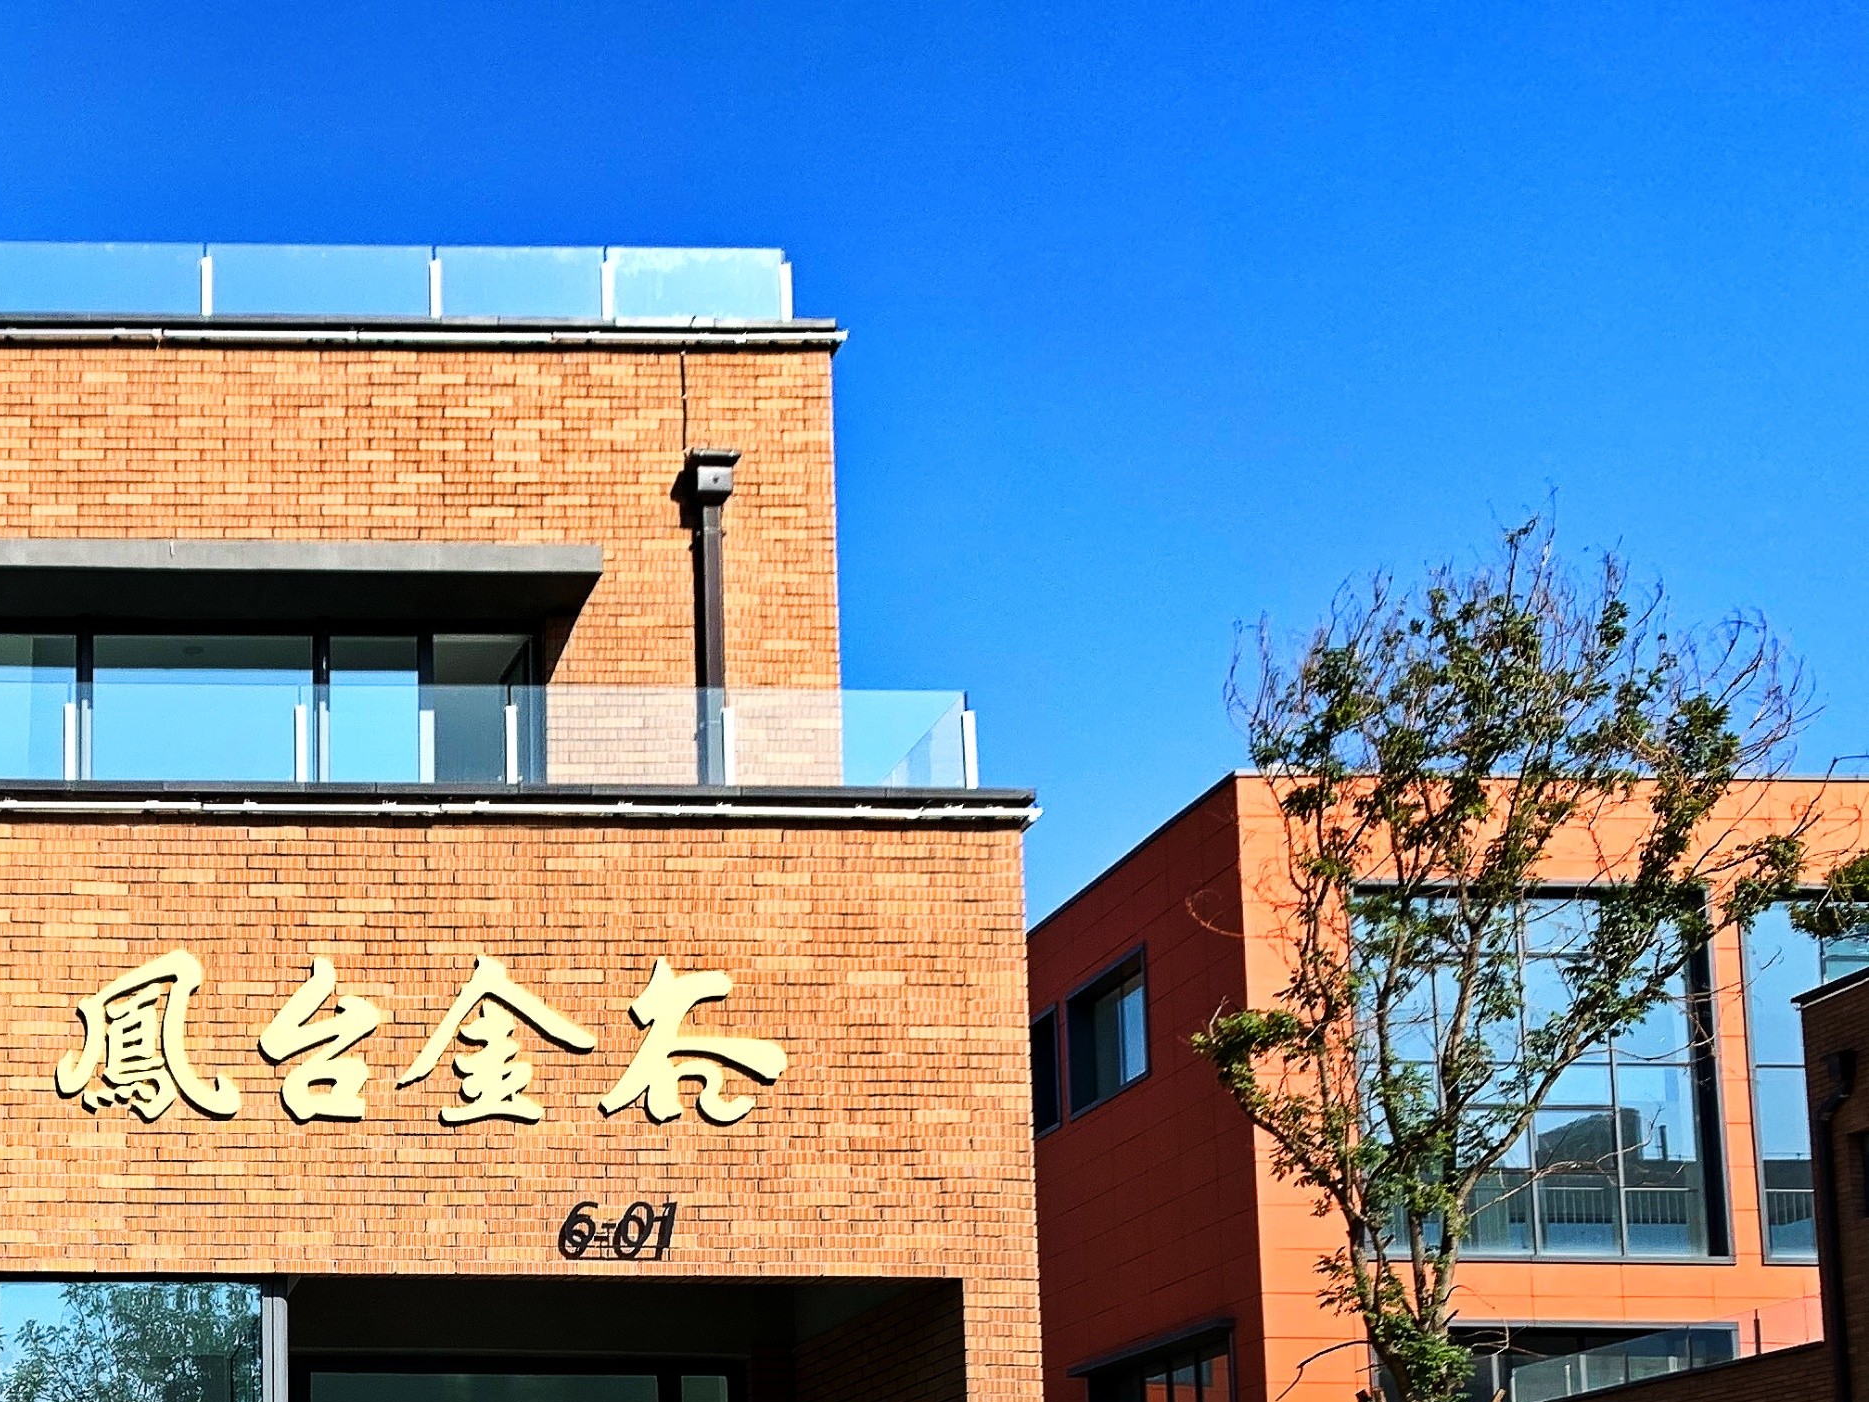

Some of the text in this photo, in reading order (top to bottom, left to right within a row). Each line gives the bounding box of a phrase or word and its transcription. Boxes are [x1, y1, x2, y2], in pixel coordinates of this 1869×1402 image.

[55, 948, 788, 1122] 鳳台金石
[558, 1200, 677, 1260] 6-01
